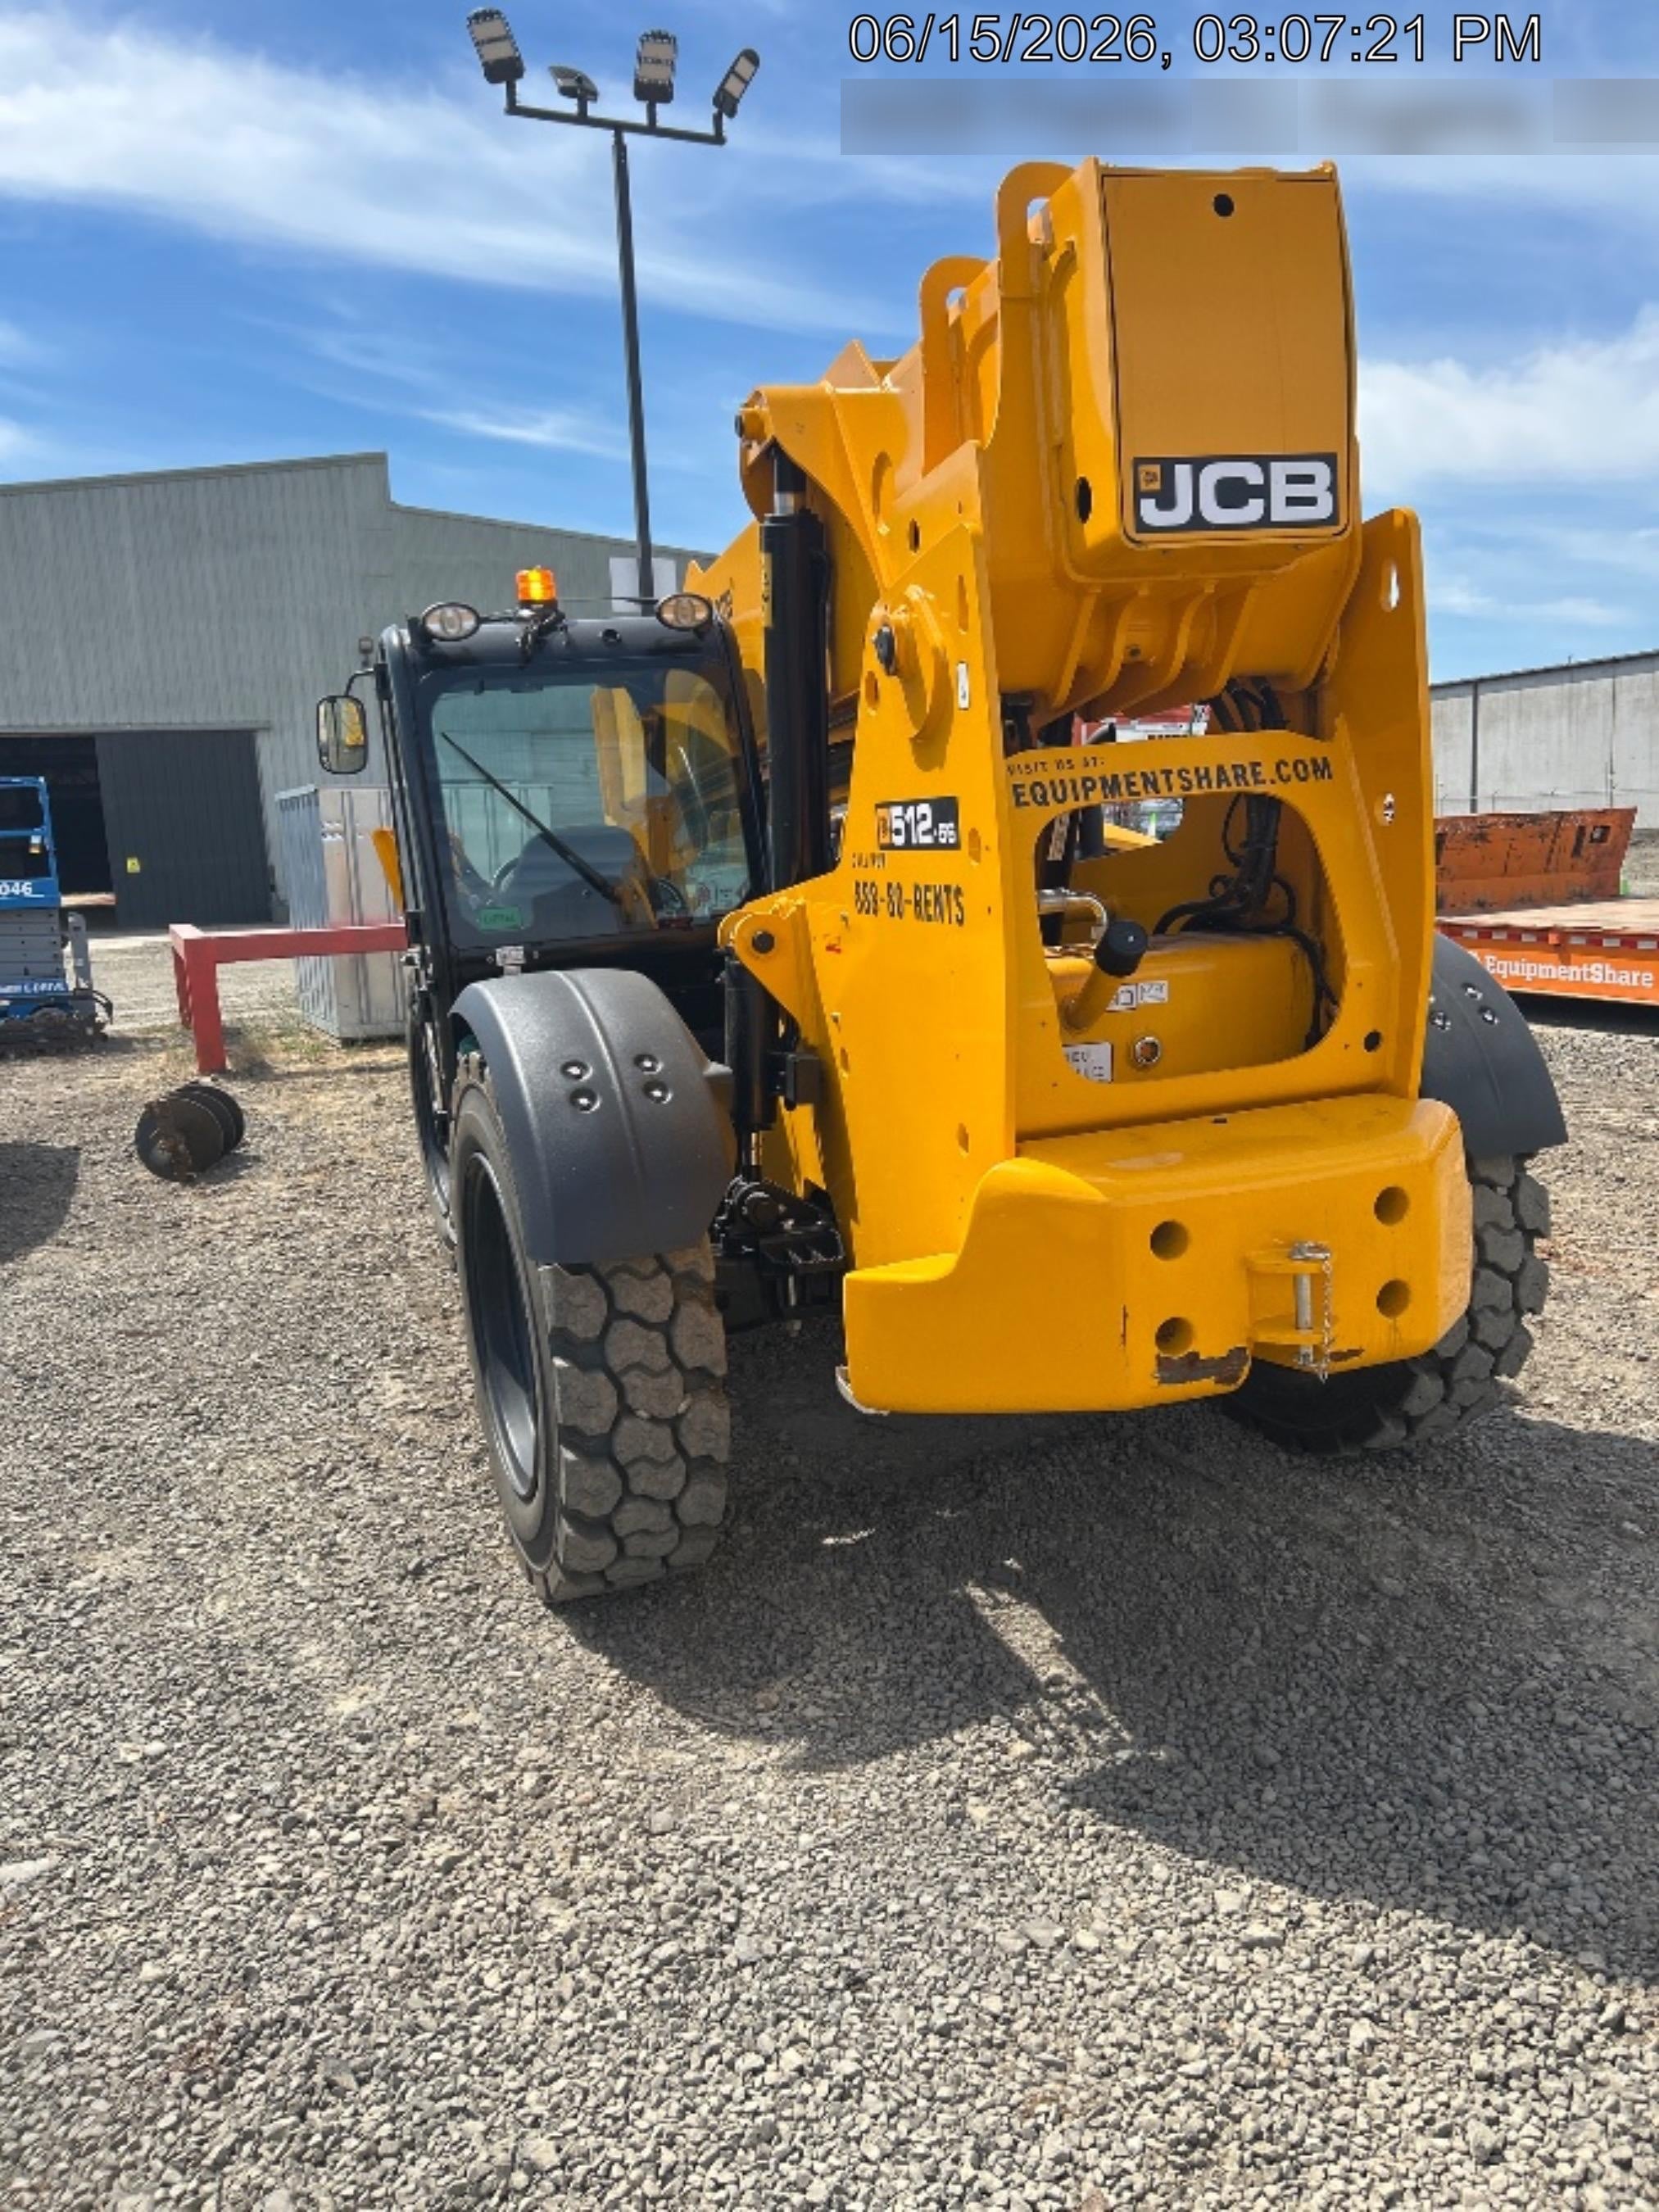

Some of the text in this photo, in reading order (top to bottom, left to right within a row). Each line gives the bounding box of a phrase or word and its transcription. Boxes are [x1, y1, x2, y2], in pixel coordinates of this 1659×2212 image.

[1140, 461, 1334, 527] JCB
[1012, 756, 1334, 808] EQUIPMENTSHARE.COM
[1484, 955, 1654, 988] EquipmentShare
